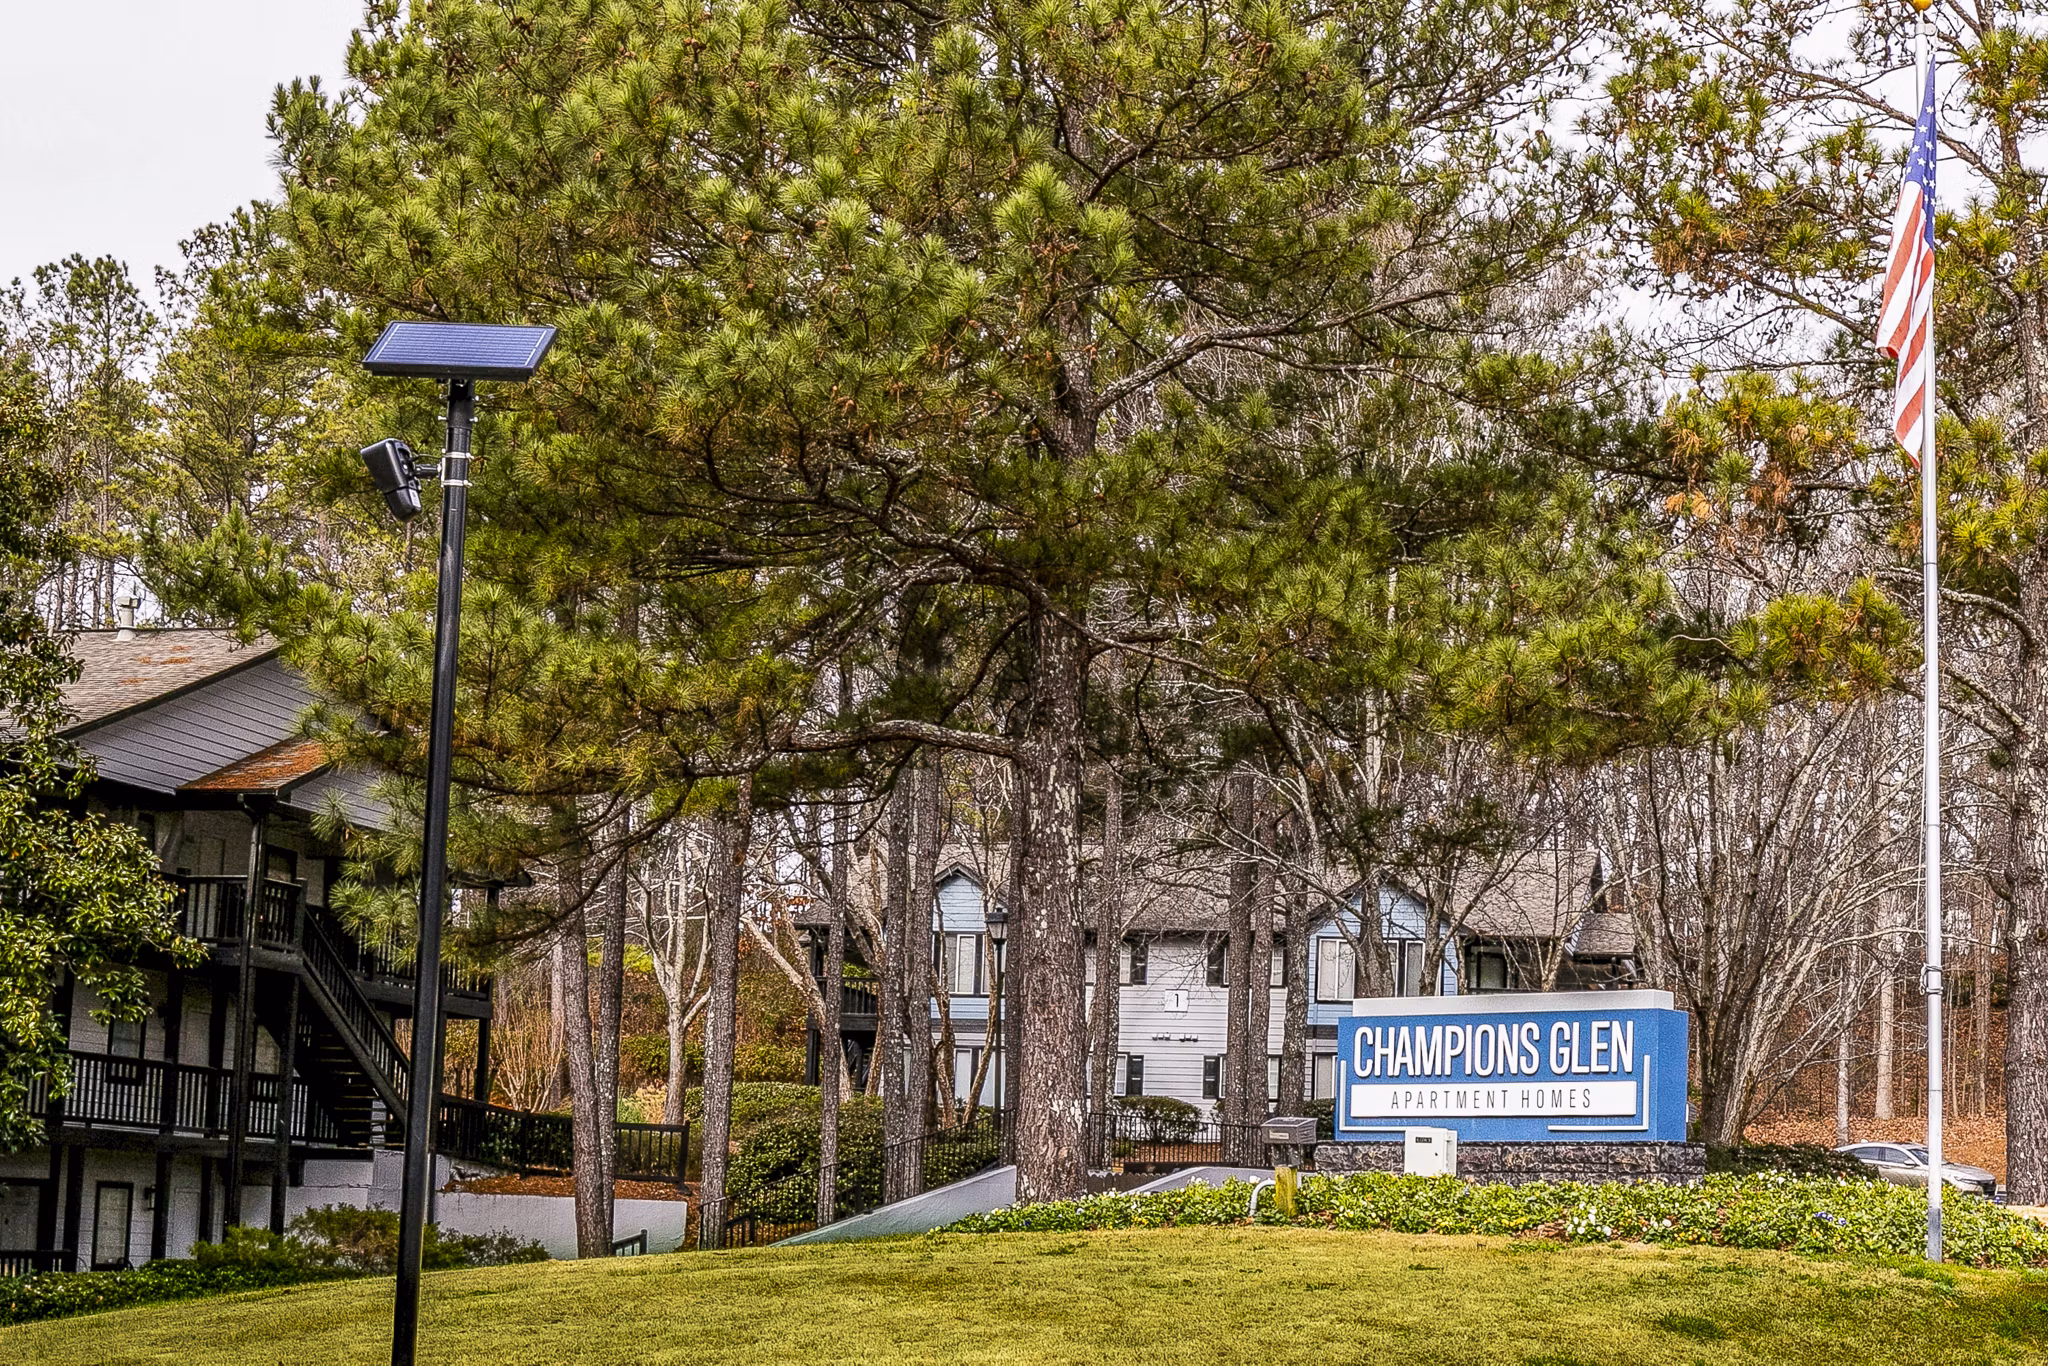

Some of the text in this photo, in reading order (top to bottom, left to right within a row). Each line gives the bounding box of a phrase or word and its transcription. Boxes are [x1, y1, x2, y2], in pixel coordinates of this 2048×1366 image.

[1174, 993, 1179, 1008] 1
[1353, 1020, 1634, 1077] CHAMPIONS GLEN
[1390, 1088, 1591, 1110] APARTMENT HOMES
